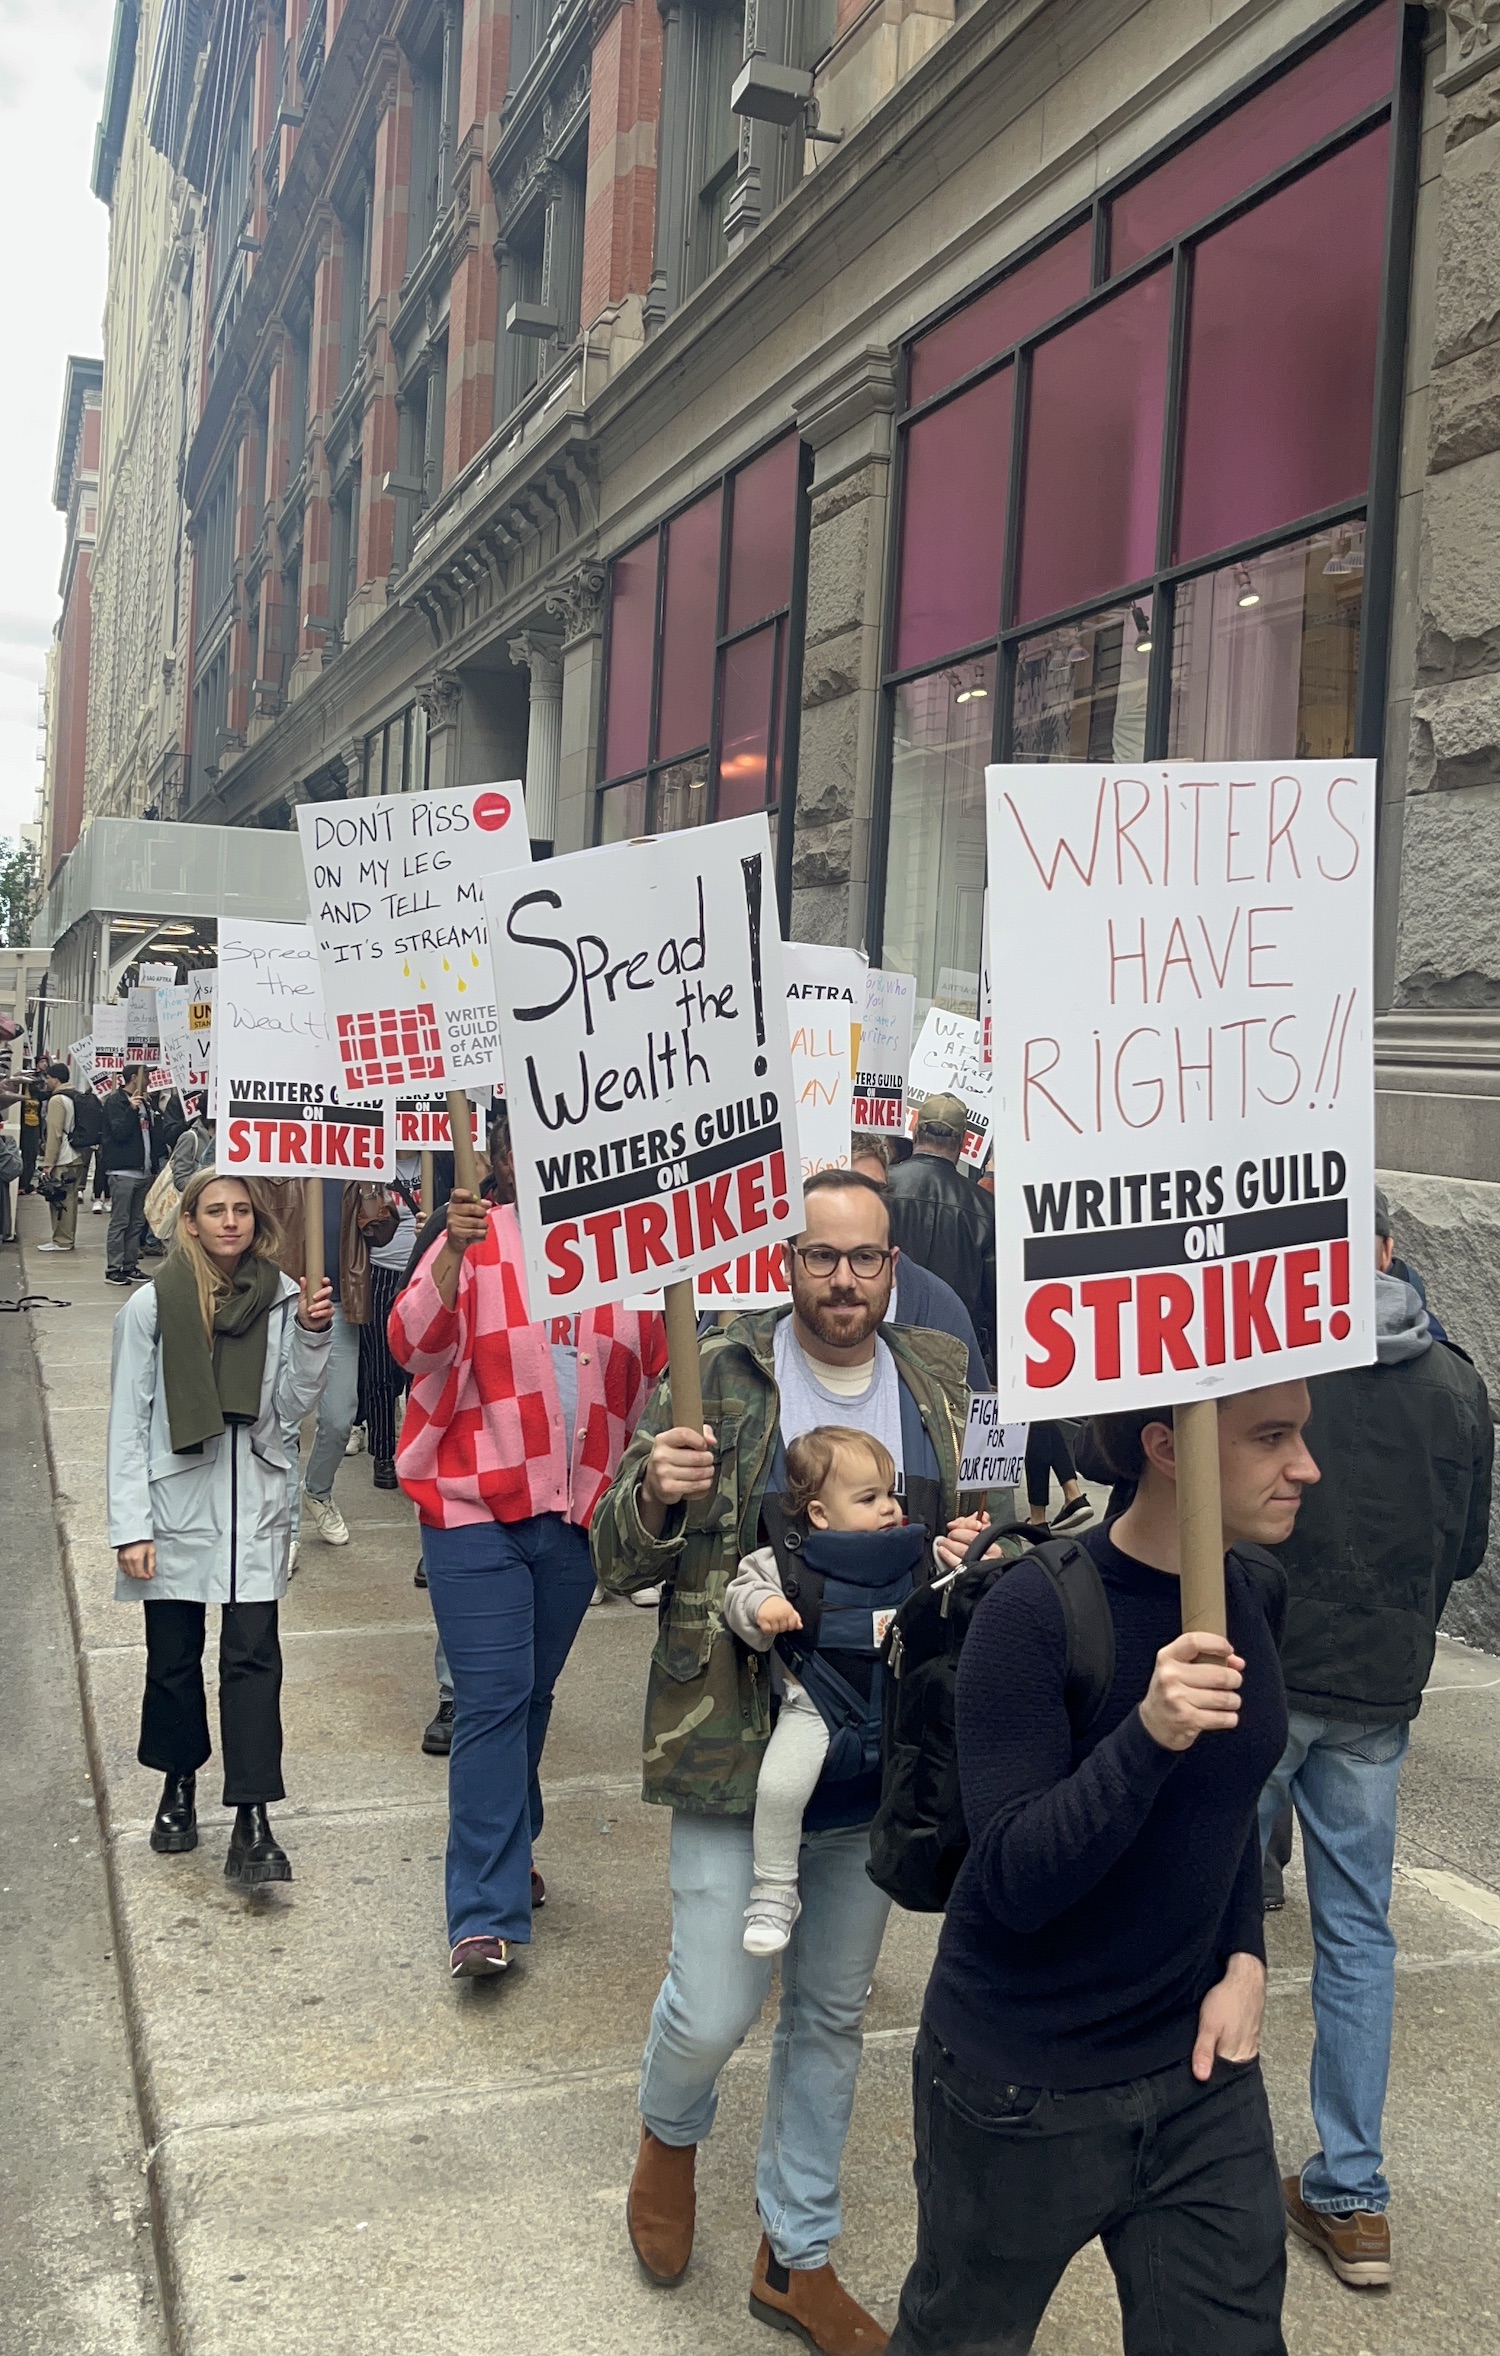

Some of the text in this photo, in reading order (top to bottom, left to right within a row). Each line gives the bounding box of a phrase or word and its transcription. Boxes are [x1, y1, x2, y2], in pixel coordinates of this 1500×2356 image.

[315, 802, 394, 850] DON'T
[314, 850, 452, 889] ON MY LEG
[320, 901, 371, 924] AND
[380, 890, 441, 919] TELL
[394, 917, 488, 954] STREAMI
[222, 941, 319, 969] Sprea
[506, 874, 706, 1036] Spread
[1108, 906, 1293, 1004] HAVE
[256, 966, 315, 995] the
[445, 1004, 496, 1023] WRITE
[676, 979, 739, 1029] the
[448, 1020, 498, 1038] GUILD
[450, 1038, 466, 1053] of
[452, 1050, 494, 1068] EAST
[95, 1055, 125, 1068] STRIK
[230, 1079, 324, 1103] WRITERS
[856, 1072, 903, 1088] TERS GUILD
[303, 1105, 324, 1121] ON
[415, 1102, 430, 1112] ON
[852, 1098, 903, 1127] RIKE!
[228, 1120, 385, 1170] STRIKE!
[536, 1091, 779, 1193] WRITERS GUILD
[657, 1161, 688, 1191] ON
[1023, 1150, 1346, 1233] WRITERS GUILD
[545, 1150, 790, 1296] STRIKE!
[1184, 1222, 1225, 1260] ON
[1025, 1239, 1352, 1389] STRIKE!
[987, 1429, 1005, 1448] FOR
[960, 1457, 1023, 1483] OUR FUTURE
